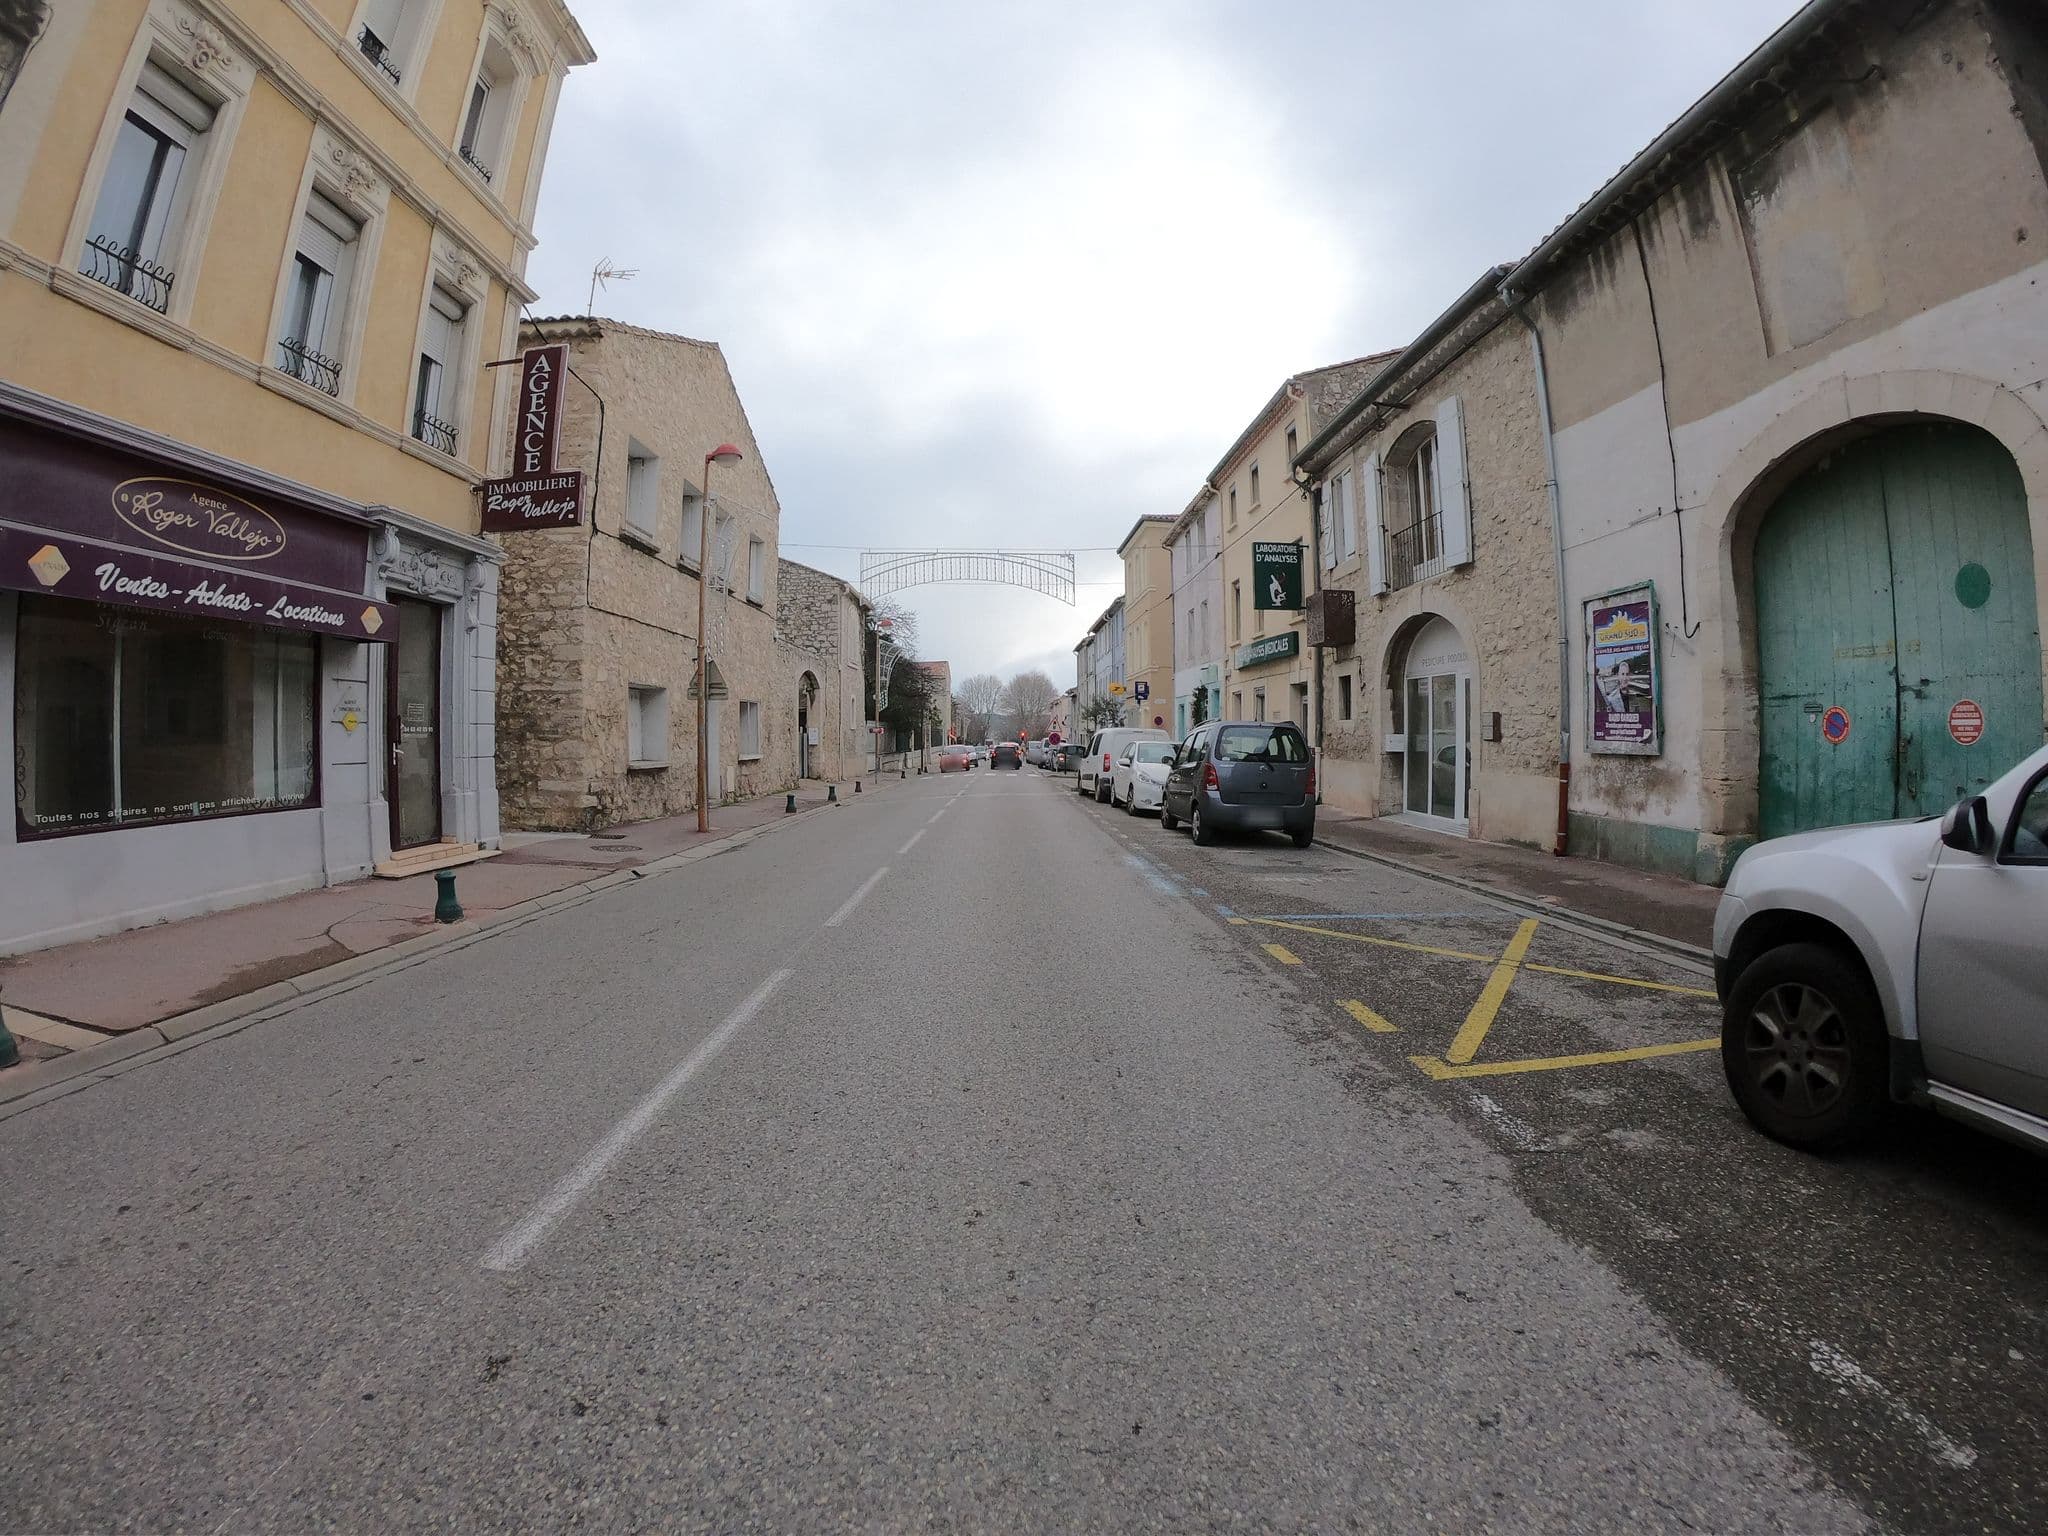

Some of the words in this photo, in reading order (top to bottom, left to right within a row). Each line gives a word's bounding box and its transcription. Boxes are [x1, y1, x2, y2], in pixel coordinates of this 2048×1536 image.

[523, 353, 552, 473] AGENCE
[488, 476, 576, 496] IMMOBILIERE
[189, 492, 229, 512] Agence
[487, 494, 532, 514] Roger
[521, 496, 576, 521] Vallejo
[132, 491, 200, 532] Roger
[205, 510, 273, 552] Vallejo
[1255, 544, 1298, 554] LABORATOIRE
[1256, 554, 1298, 564] D'ANALYSES
[95, 562, 170, 599] Ventes
[184, 580, 253, 612] Achats
[265, 595, 346, 627] Locations
[35, 812, 73, 824] Toutes
[80, 811, 100, 820] nos
[107, 807, 148, 818] affaires
[154, 806, 166, 814] ne
[172, 802, 194, 812] sont
[199, 801, 216, 811] pas
